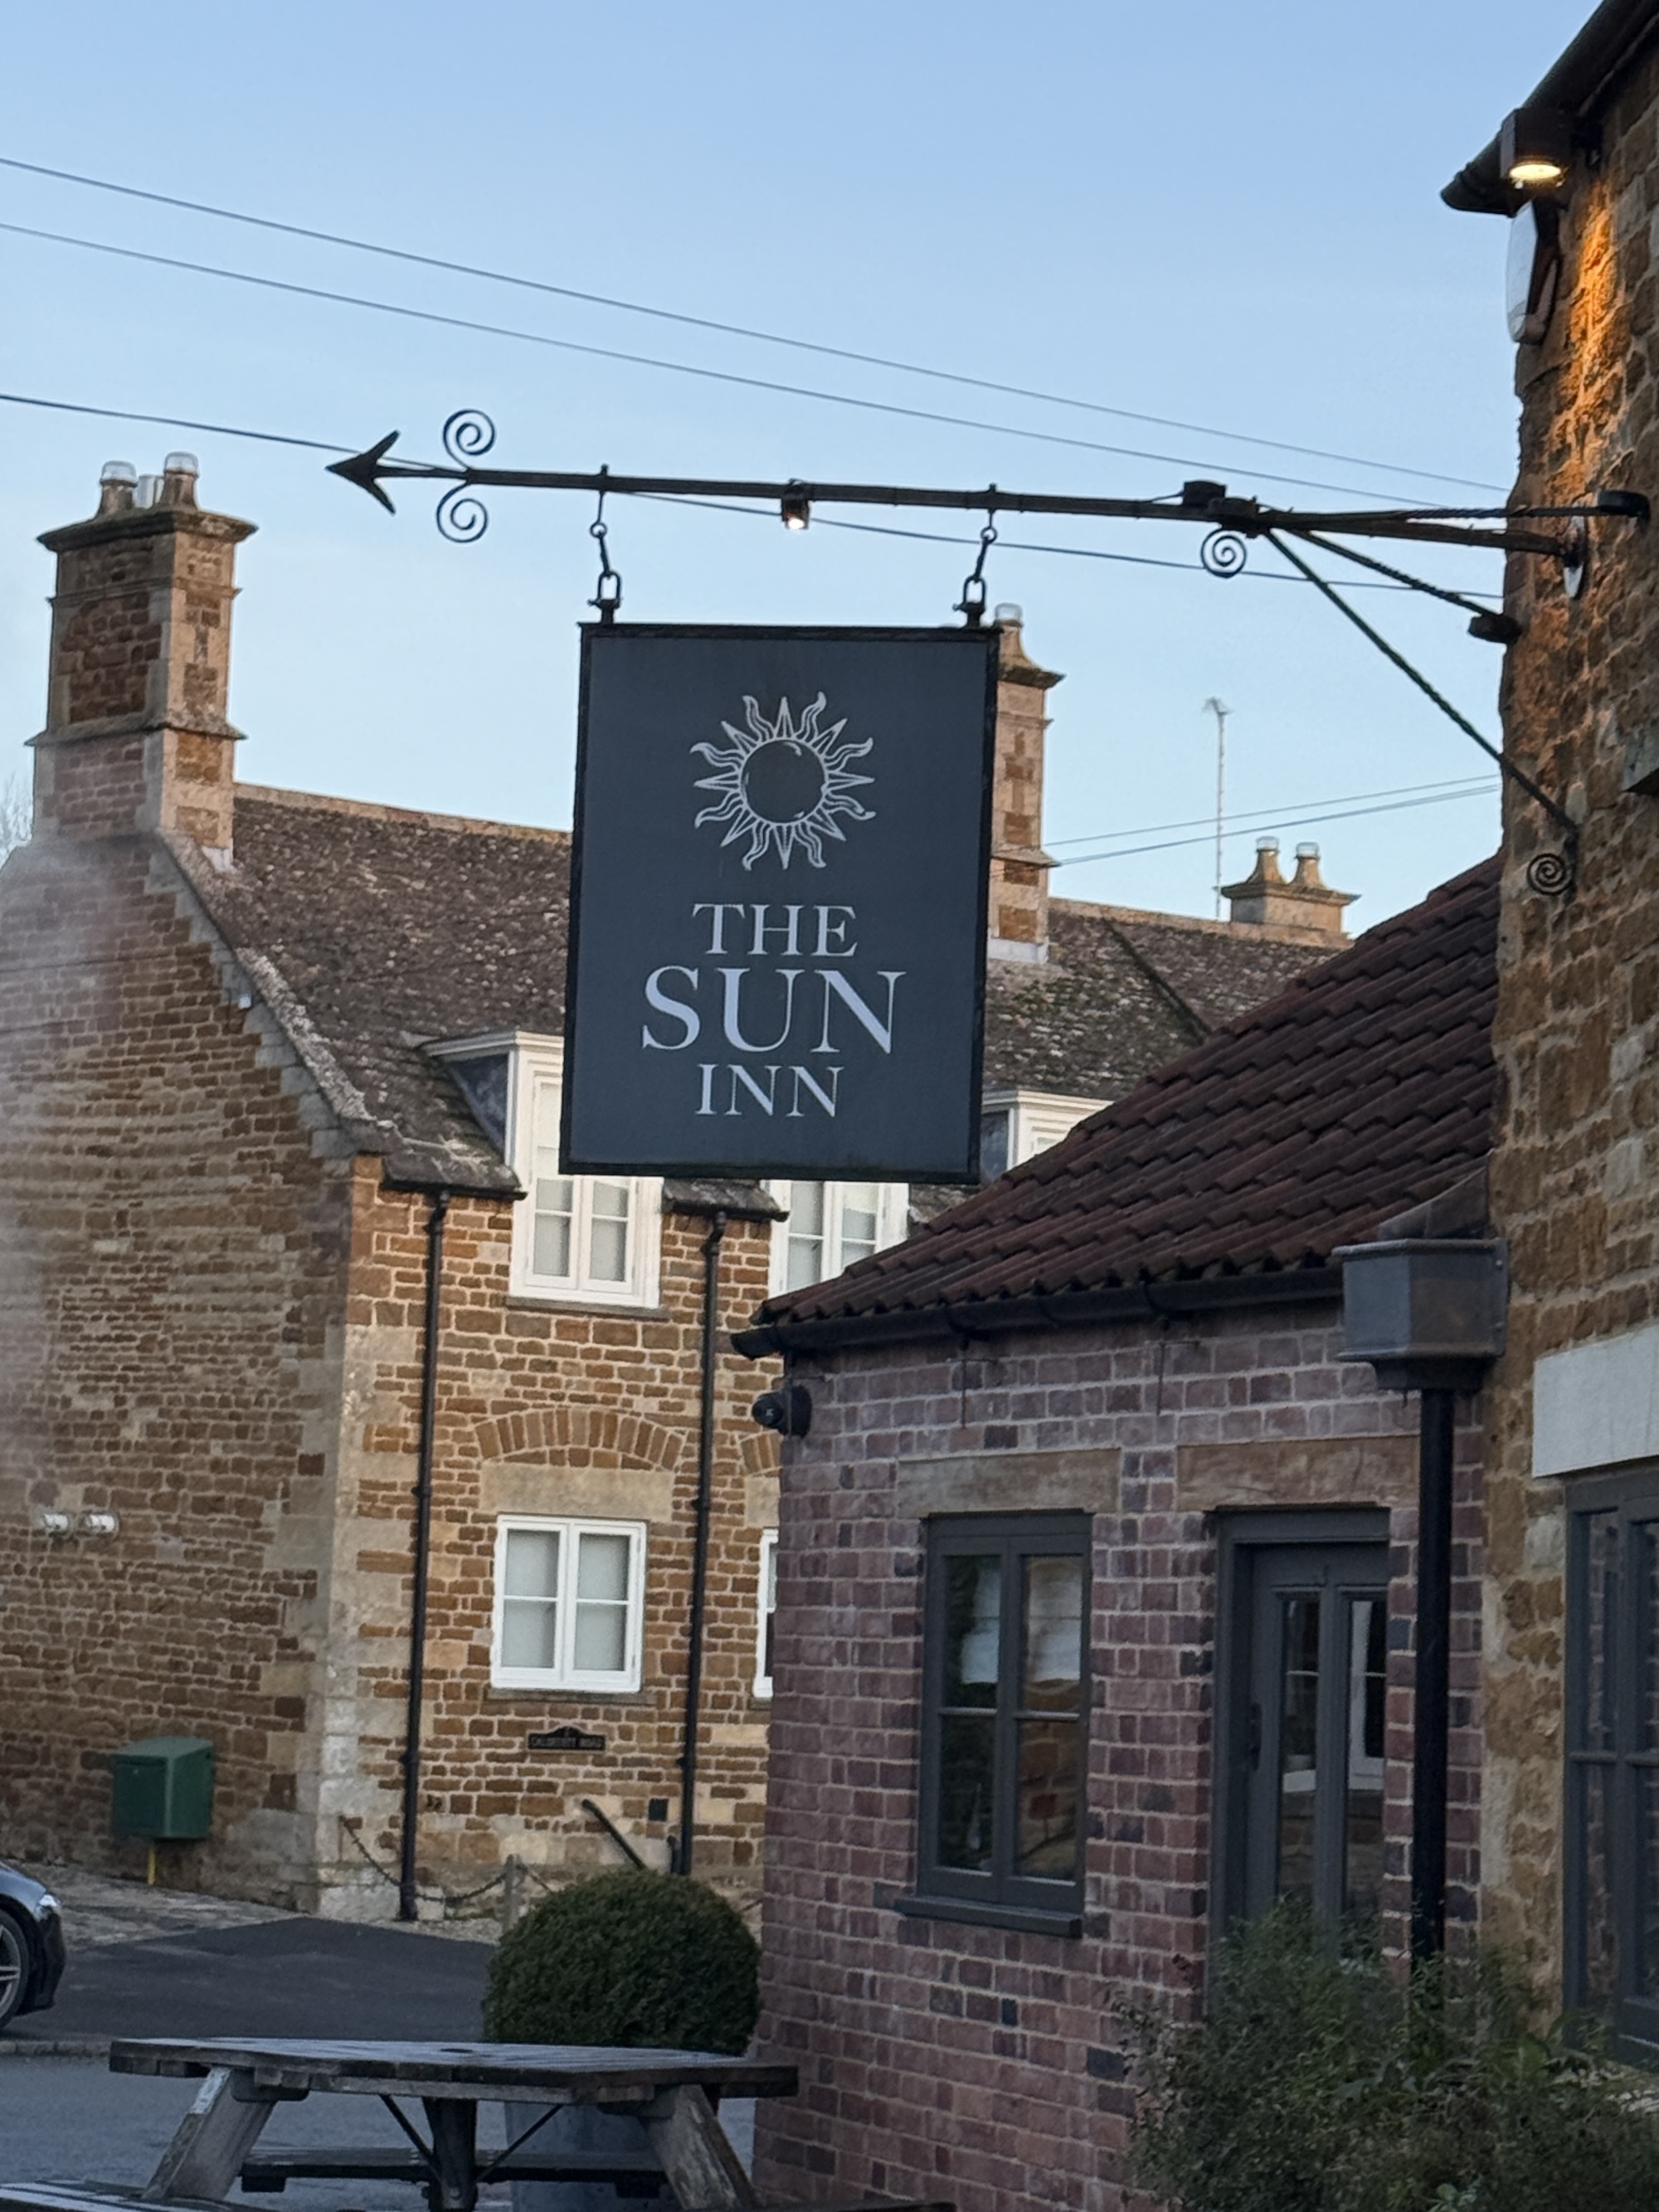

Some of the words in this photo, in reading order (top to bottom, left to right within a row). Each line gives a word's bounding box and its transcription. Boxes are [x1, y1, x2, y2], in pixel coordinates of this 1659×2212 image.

[692, 903, 858, 956] THE
[642, 965, 906, 1053] SUN
[695, 1063, 844, 1117] INN
